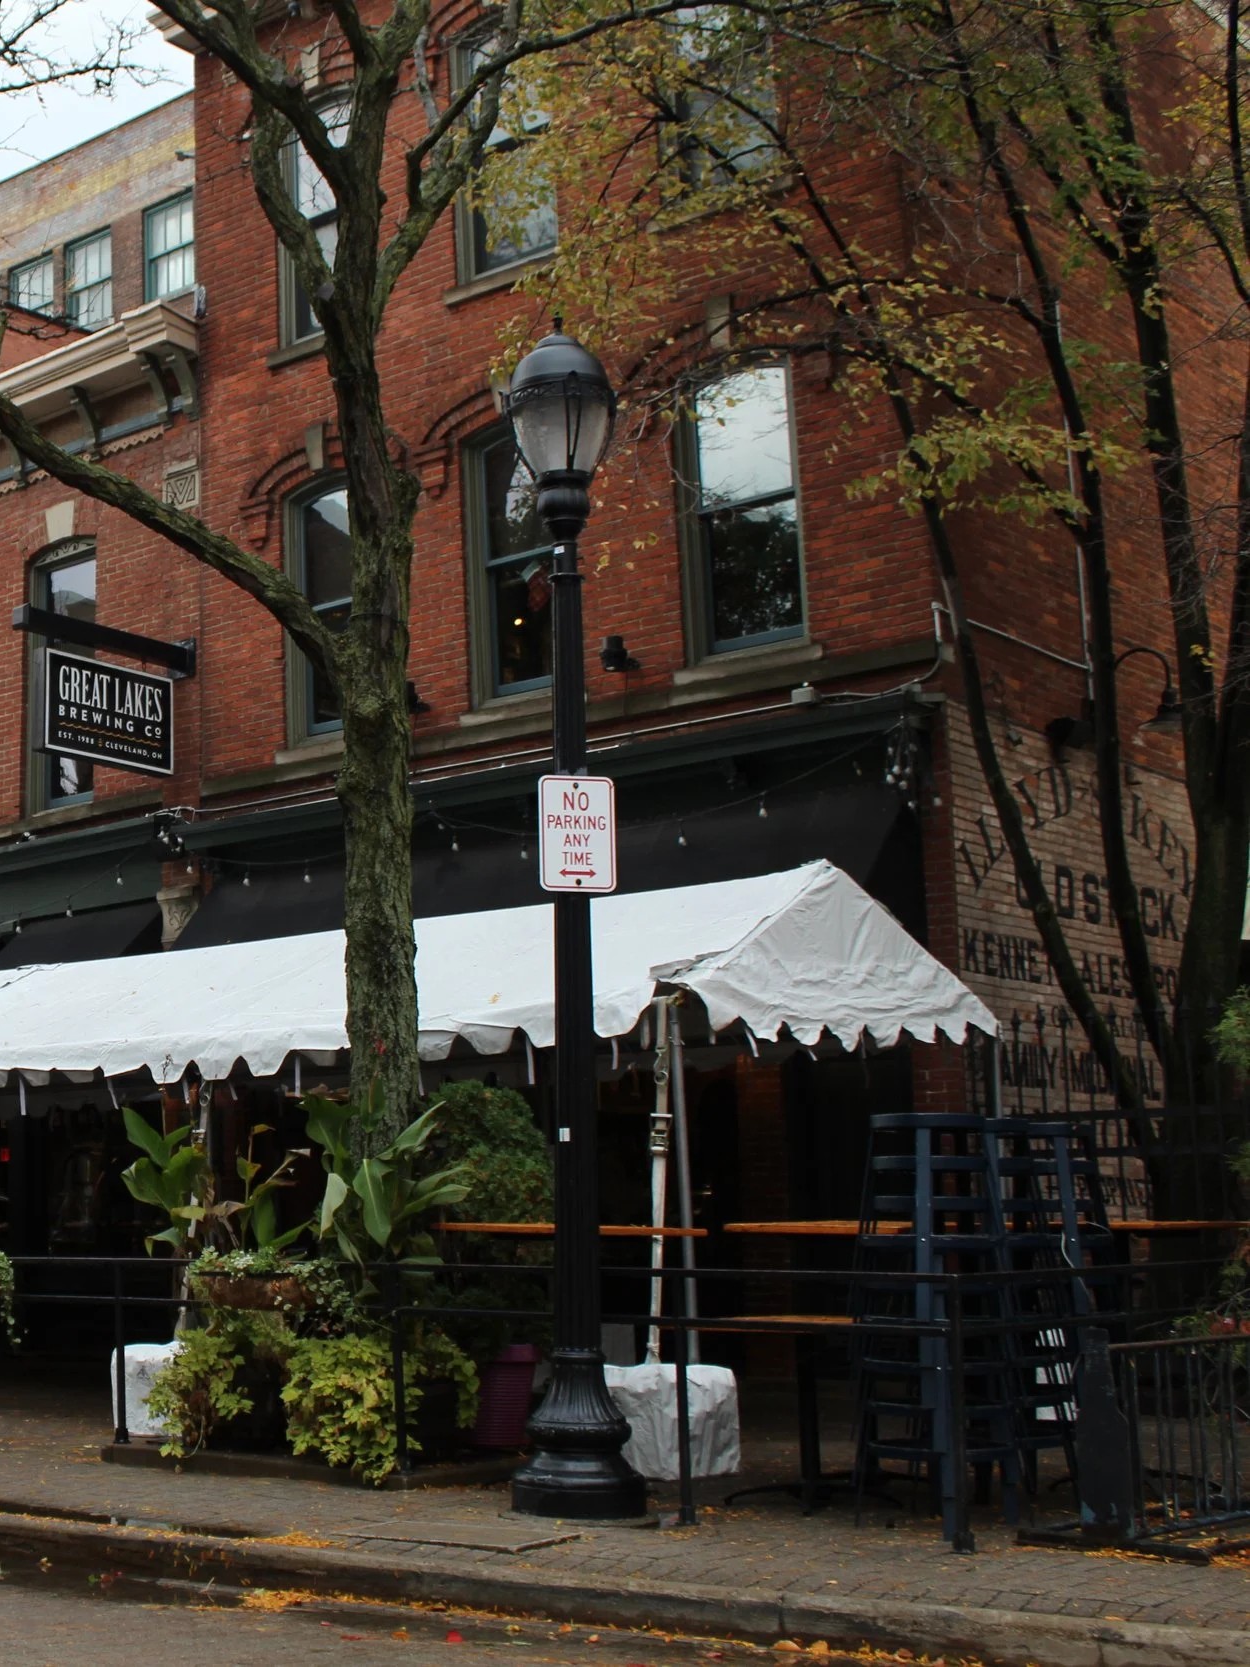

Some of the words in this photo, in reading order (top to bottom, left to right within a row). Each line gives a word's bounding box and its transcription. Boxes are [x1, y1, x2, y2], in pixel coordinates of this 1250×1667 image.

[59, 665, 110, 710] GREAT
[114, 677, 163, 722] LAKES
[58, 704, 134, 732] BREWING
[58, 730, 75, 740] EST.
[77, 735, 94, 744] 1988
[105, 741, 150, 757] CLEVELAND,
[151, 752, 162, 760] OH
[563, 792, 590, 811] NO
[547, 815, 606, 831] PARKING
[957, 765, 1073, 894] LLYD
[563, 834, 591, 847] ANY
[562, 851, 594, 866] TIME
[1000, 1041, 1057, 1089] AMILY
